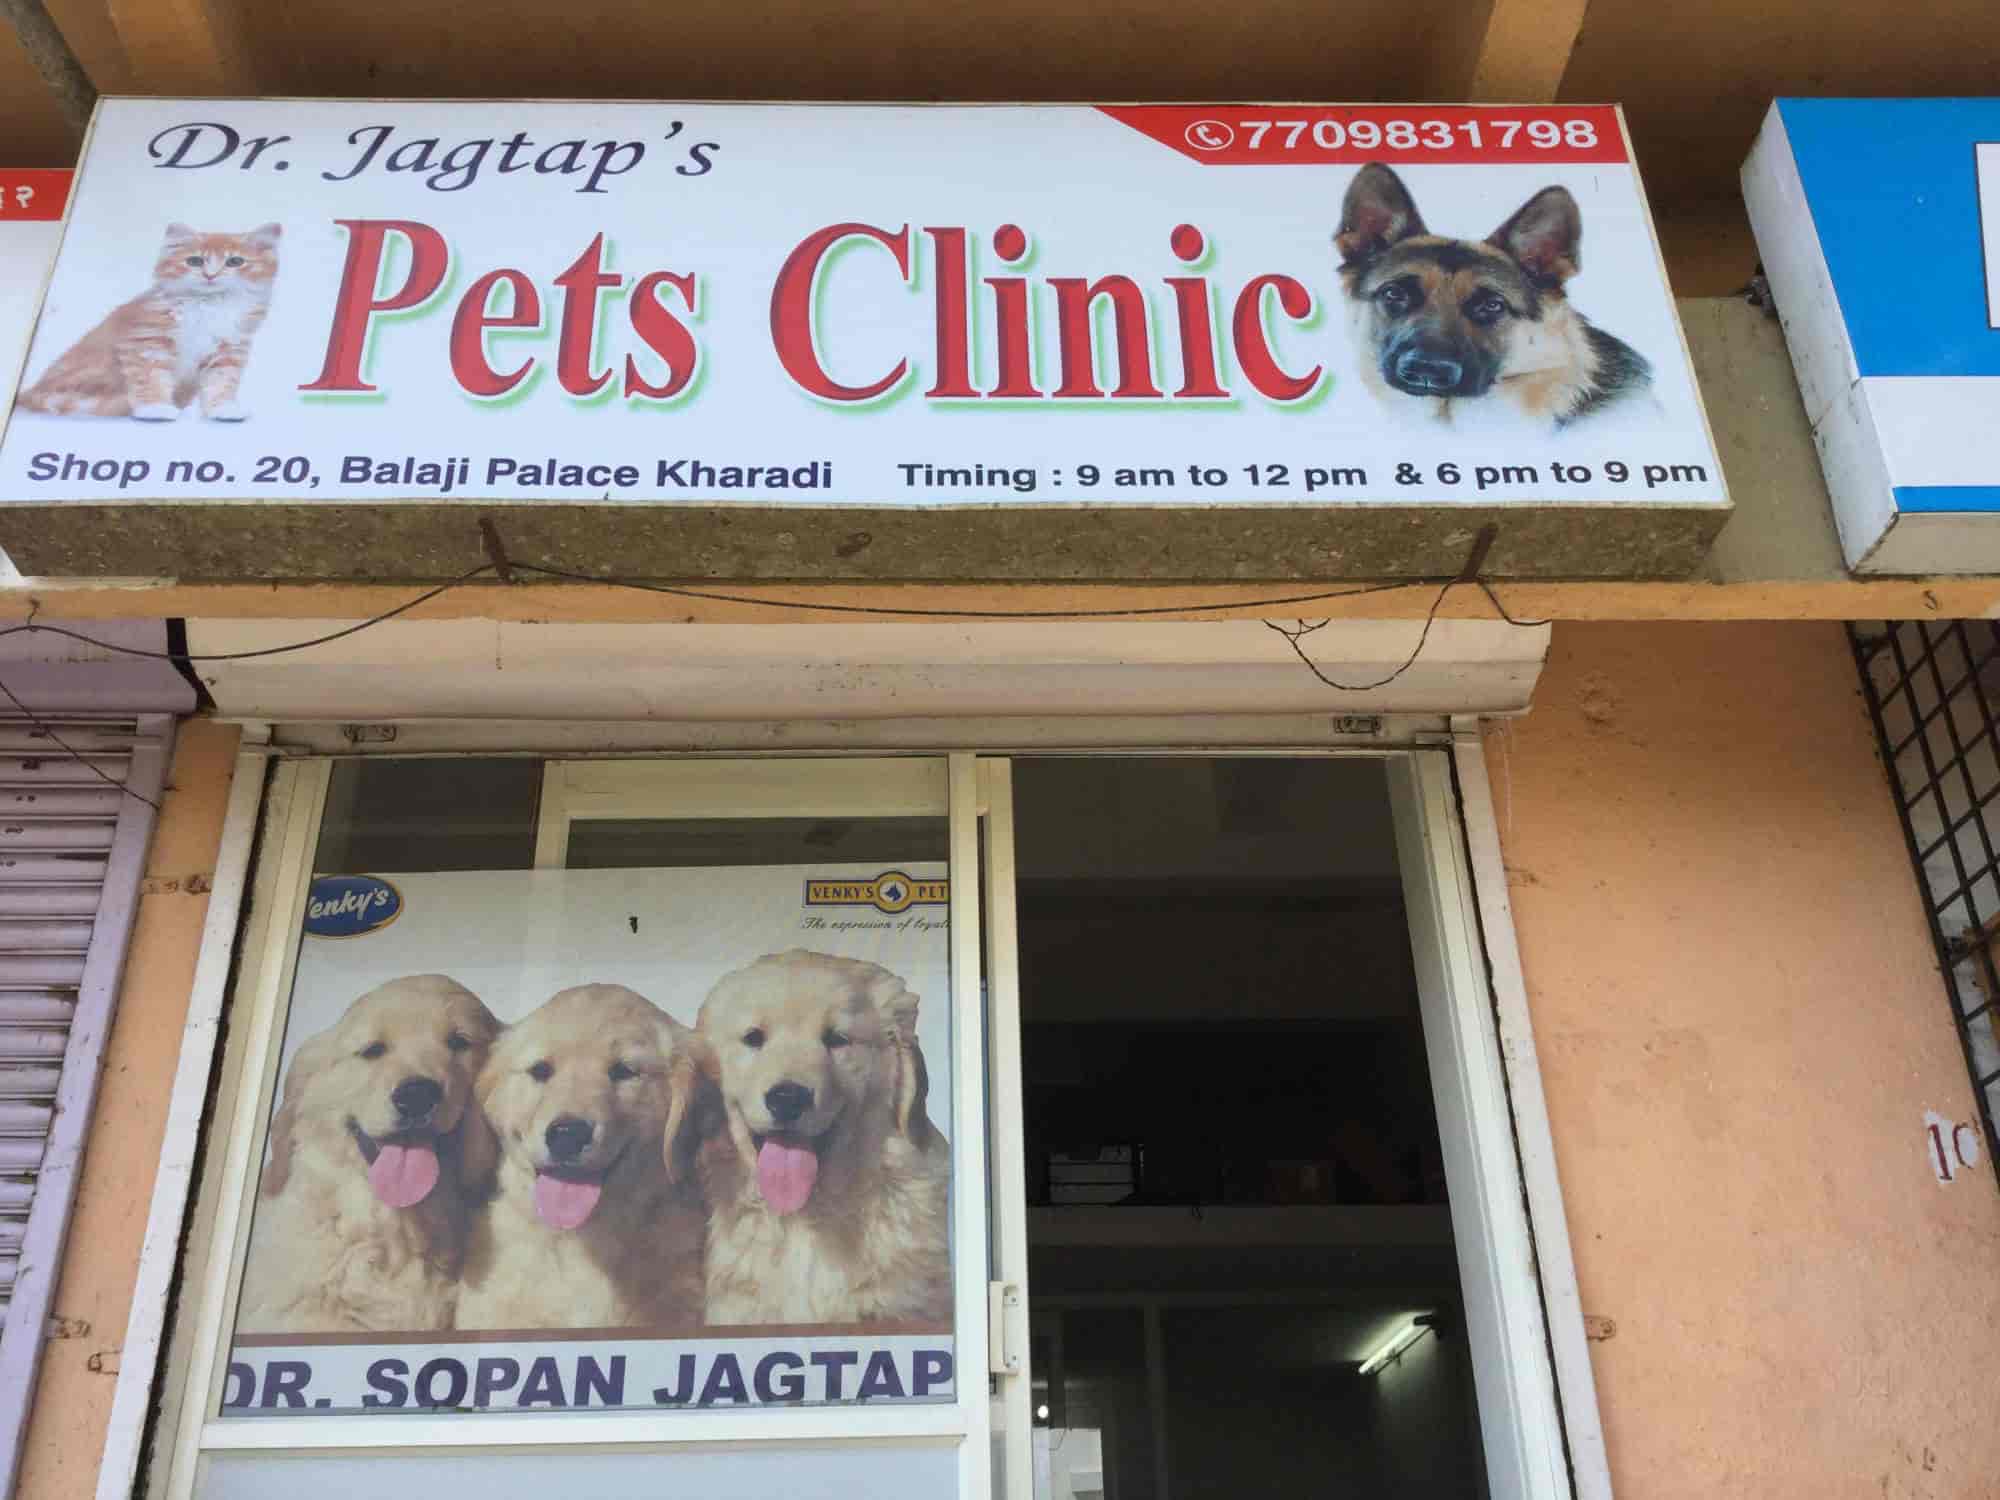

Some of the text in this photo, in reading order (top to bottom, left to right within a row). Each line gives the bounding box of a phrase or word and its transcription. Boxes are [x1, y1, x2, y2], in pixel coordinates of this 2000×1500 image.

[1239, 119, 1598, 150] 7709831798
[148, 120, 721, 193] Dr. Jagtap’s
[298, 219, 1323, 402] Pets Clinic
[28, 452, 832, 493] Shop no. 20, Balaji Palace Kharadi
[897, 463, 1037, 493] Timing
[1076, 464, 1100, 487] 9
[1114, 468, 1175, 487] am
[1187, 465, 1228, 487] to
[1243, 464, 1290, 486] 12
[1304, 468, 1367, 492] pm
[1394, 462, 1423, 486] &
[1436, 462, 1461, 485] 6
[1475, 466, 1539, 490] pm
[1550, 462, 1592, 484] to
[1604, 461, 1629, 483] 9
[1643, 465, 1708, 489] pm
[308, 887, 389, 921] enky's
[223, 1350, 954, 1409] DR. SOPAN JAGTAP
